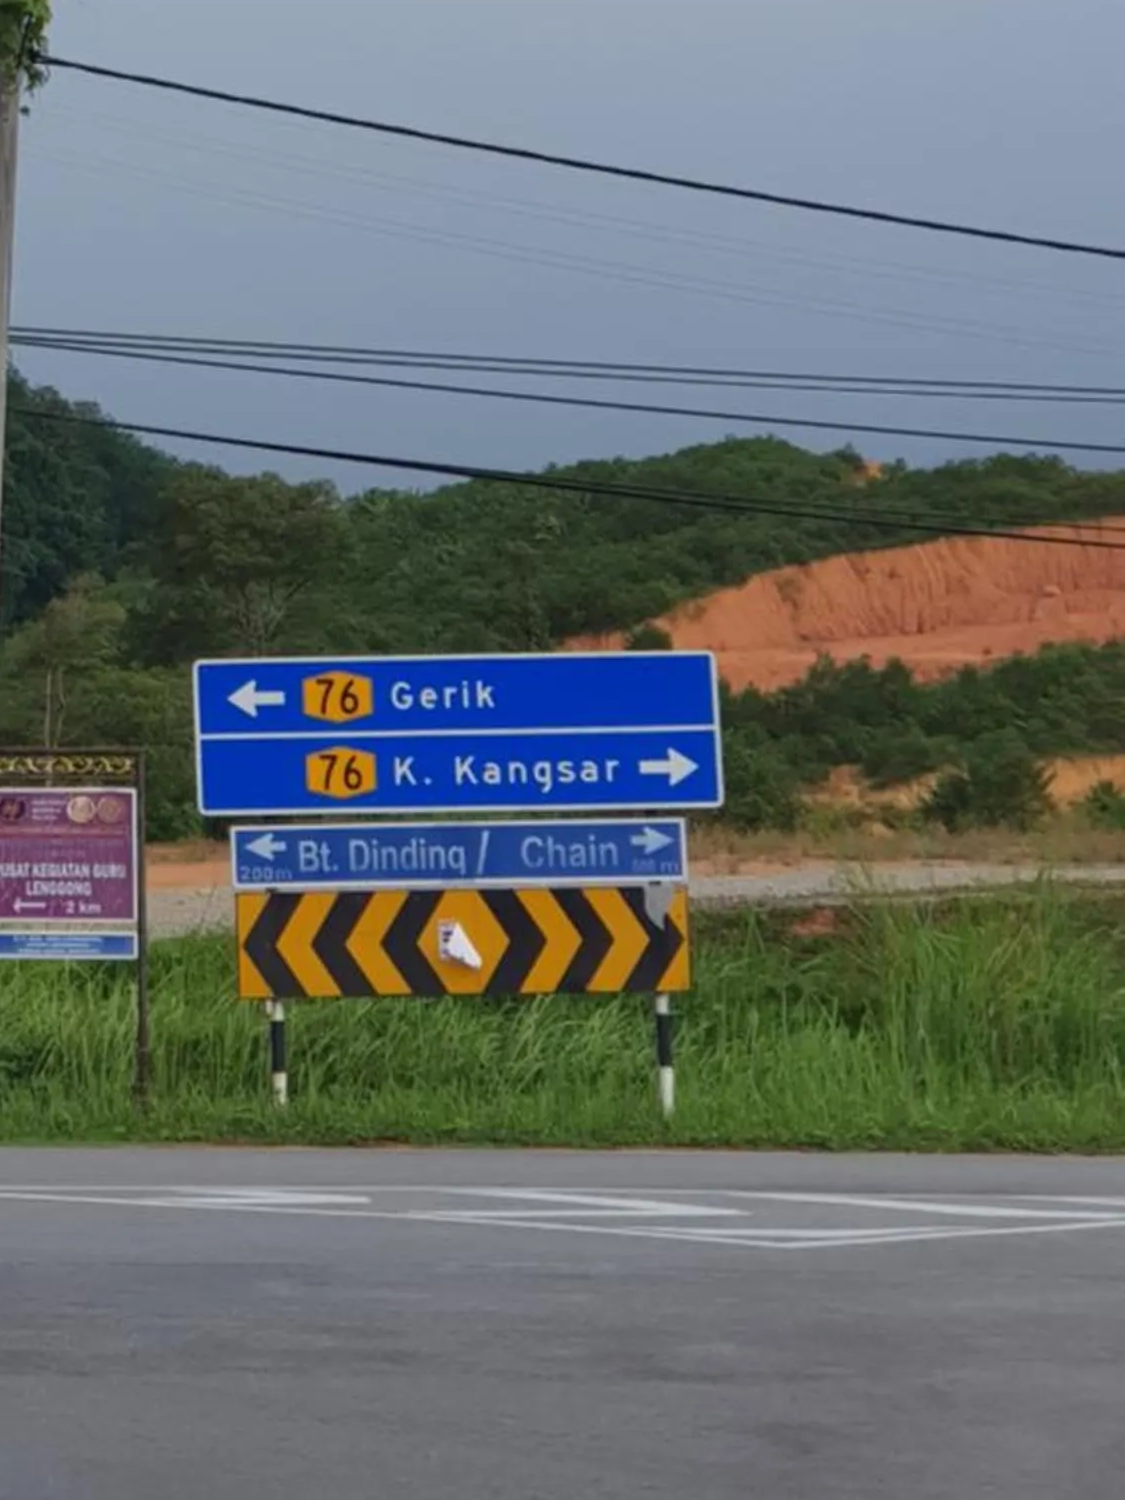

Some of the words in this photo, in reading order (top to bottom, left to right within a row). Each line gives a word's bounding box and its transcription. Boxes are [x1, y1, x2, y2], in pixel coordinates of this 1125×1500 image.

[315, 678, 359, 714] 76
[390, 679, 496, 710] Gerik
[319, 754, 363, 791] 76
[393, 756, 432, 787] K.
[454, 756, 620, 794] Kangsar
[298, 840, 339, 873] Bt.
[520, 833, 619, 869] Chain
